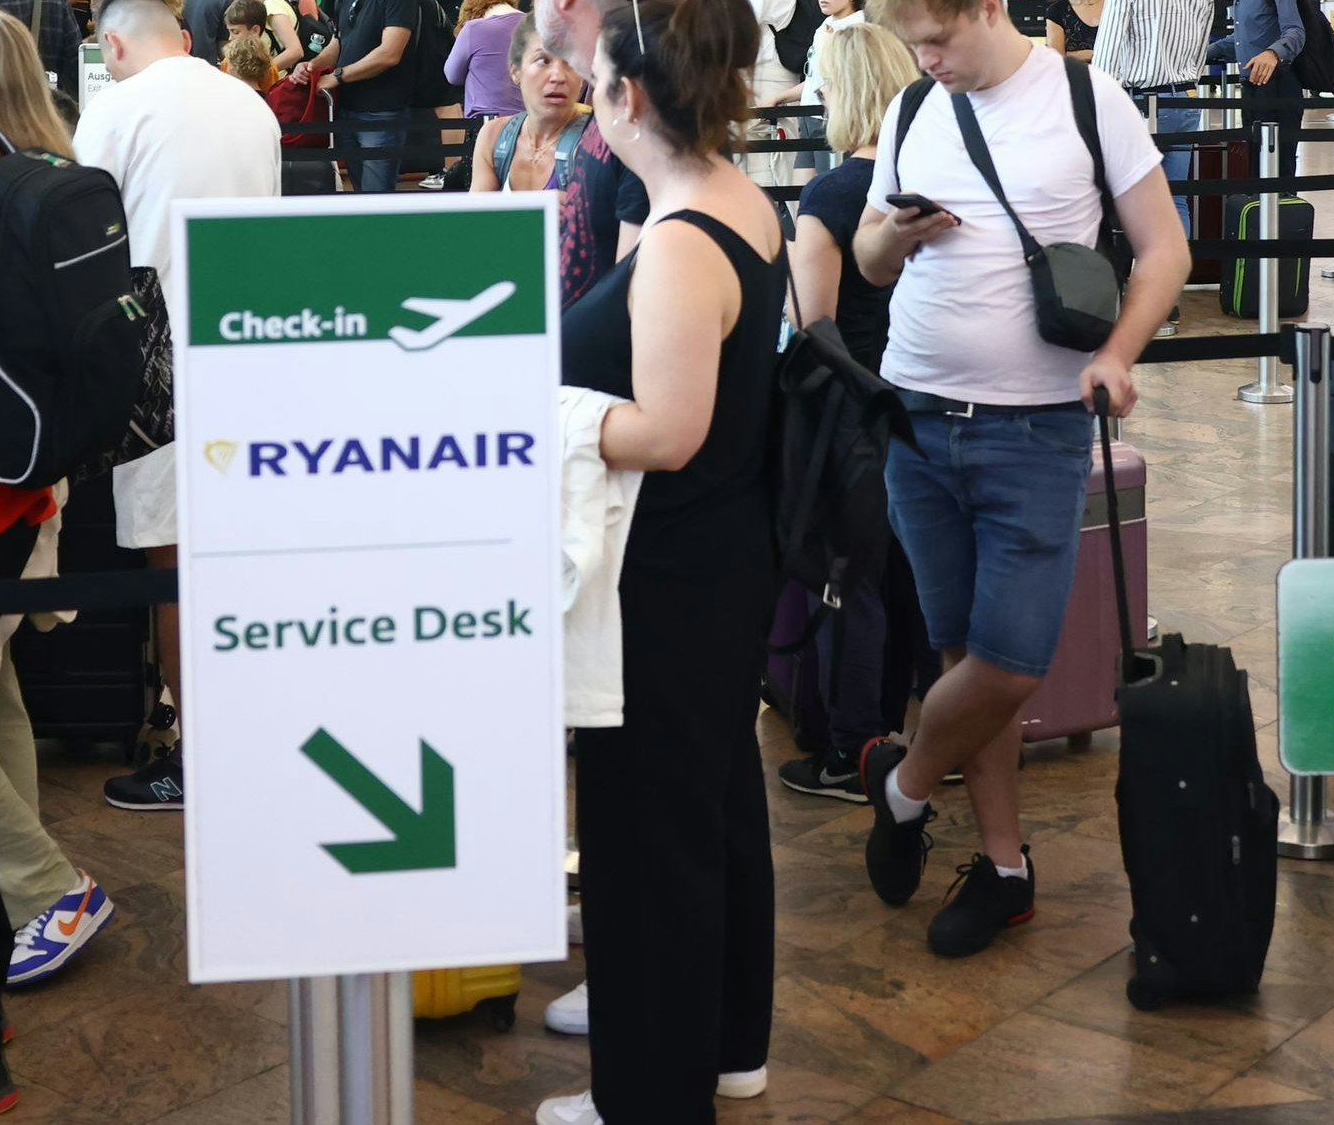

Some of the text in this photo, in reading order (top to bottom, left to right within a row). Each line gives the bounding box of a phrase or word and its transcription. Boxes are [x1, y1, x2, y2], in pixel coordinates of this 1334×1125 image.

[88, 72, 111, 83] Ausg
[219, 307, 368, 341] Check-in
[249, 432, 535, 478] RYANAIR
[213, 600, 532, 651] Service Desk
